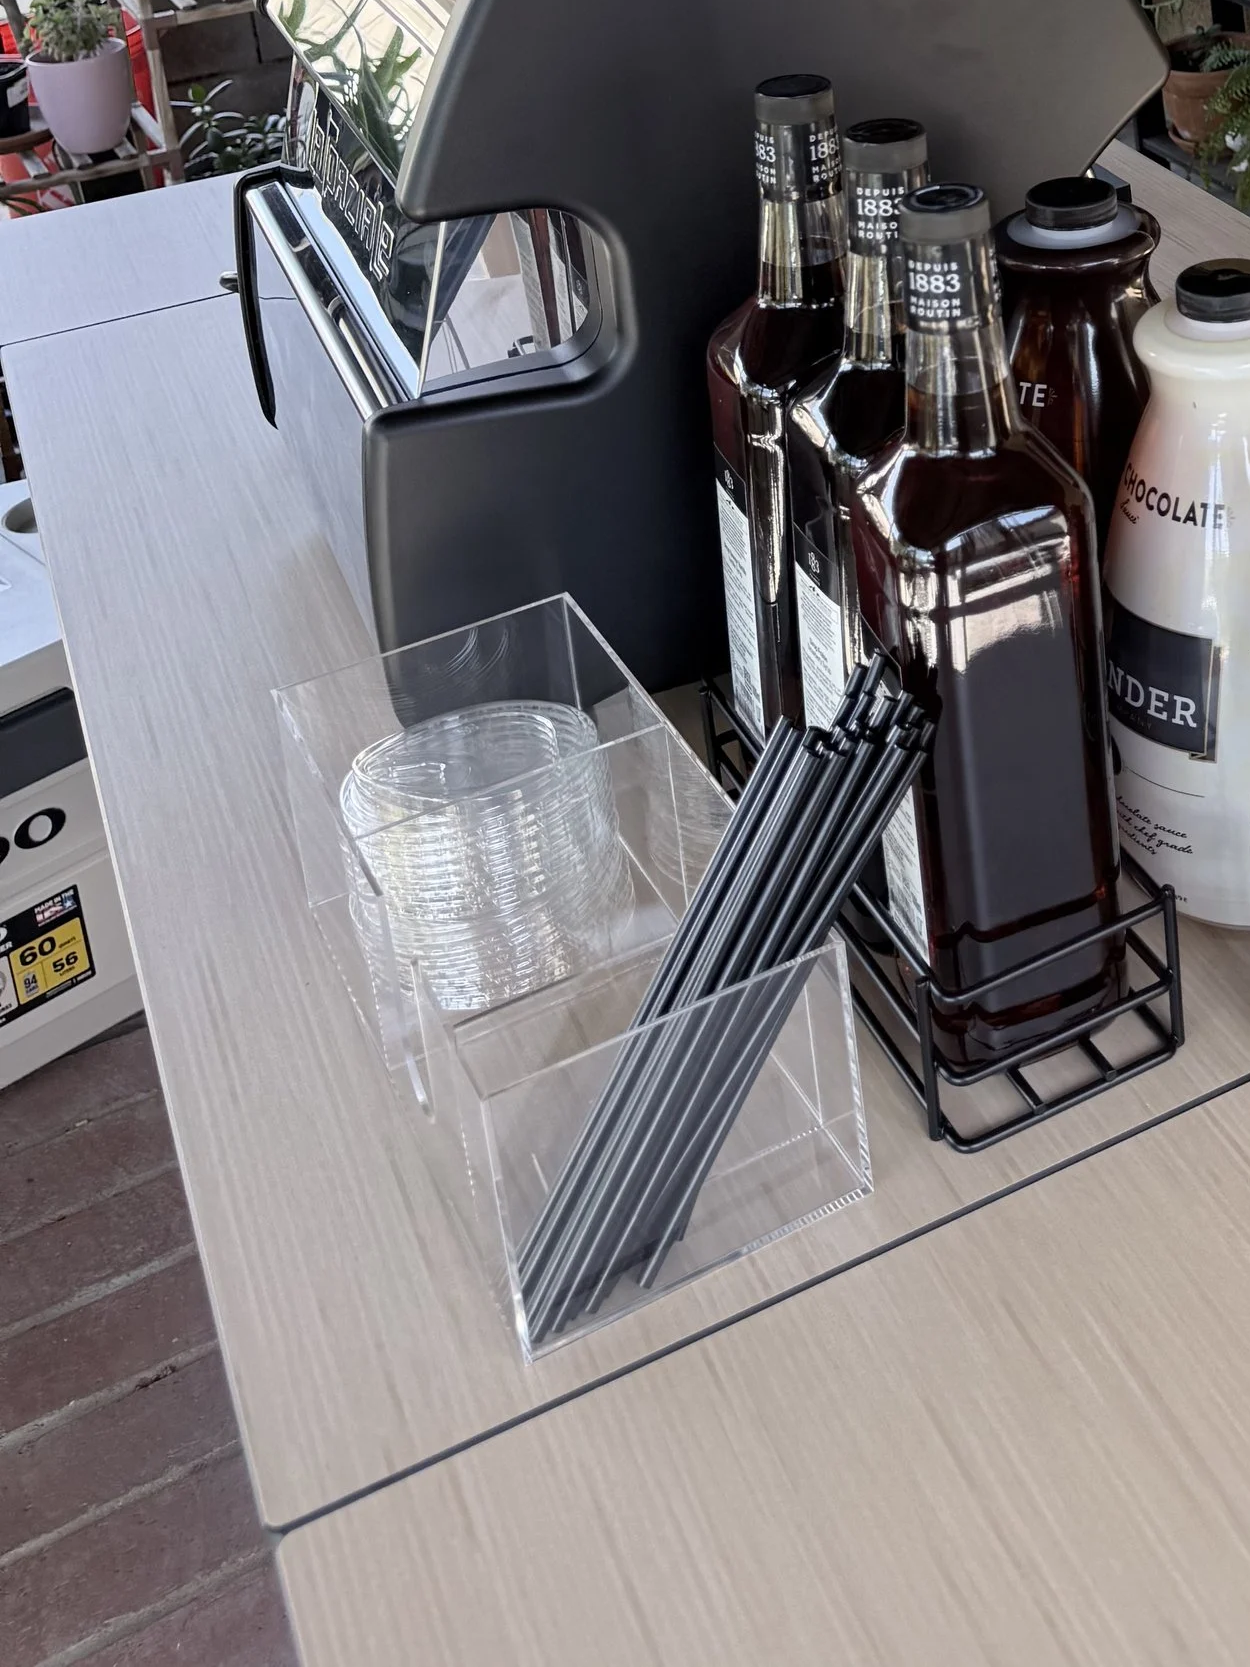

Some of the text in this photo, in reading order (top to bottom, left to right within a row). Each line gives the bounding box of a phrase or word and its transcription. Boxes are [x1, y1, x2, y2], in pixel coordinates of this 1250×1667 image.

[856, 187, 905, 197] DEPUIS
[908, 259, 958, 272] DEPUIS
[909, 272, 961, 293] 1883
[910, 295, 961, 309] MAISON
[910, 305, 961, 318] ROUTIN
[1124, 462, 1225, 529] CHOCOLATE
[0, 807, 67, 865] O
[1154, 823, 1187, 839] sauce
[19, 936, 57, 966] 60
[52, 951, 79, 973] 56
[24, 973, 38, 989] 94
